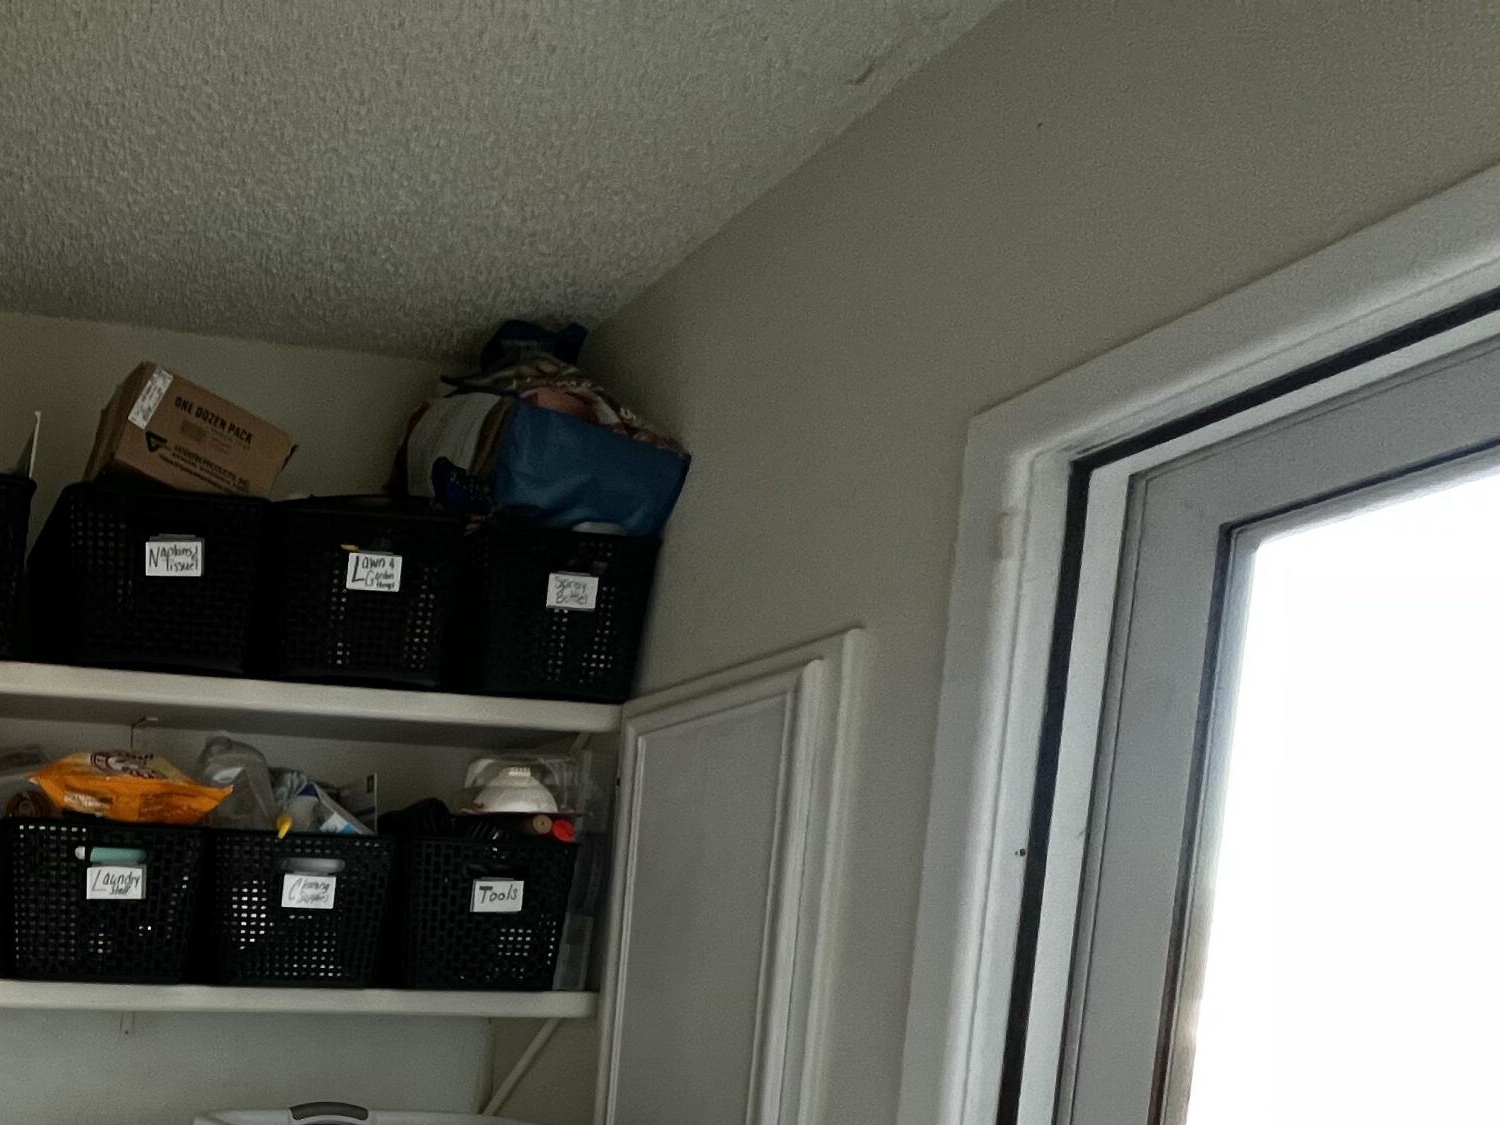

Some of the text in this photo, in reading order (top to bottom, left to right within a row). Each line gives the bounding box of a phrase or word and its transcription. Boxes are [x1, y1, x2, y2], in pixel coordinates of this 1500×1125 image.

[174, 396, 194, 415] ONE
[195, 407, 227, 431] DOZEN
[228, 423, 253, 445] PACK
[479, 884, 518, 904] Tools
